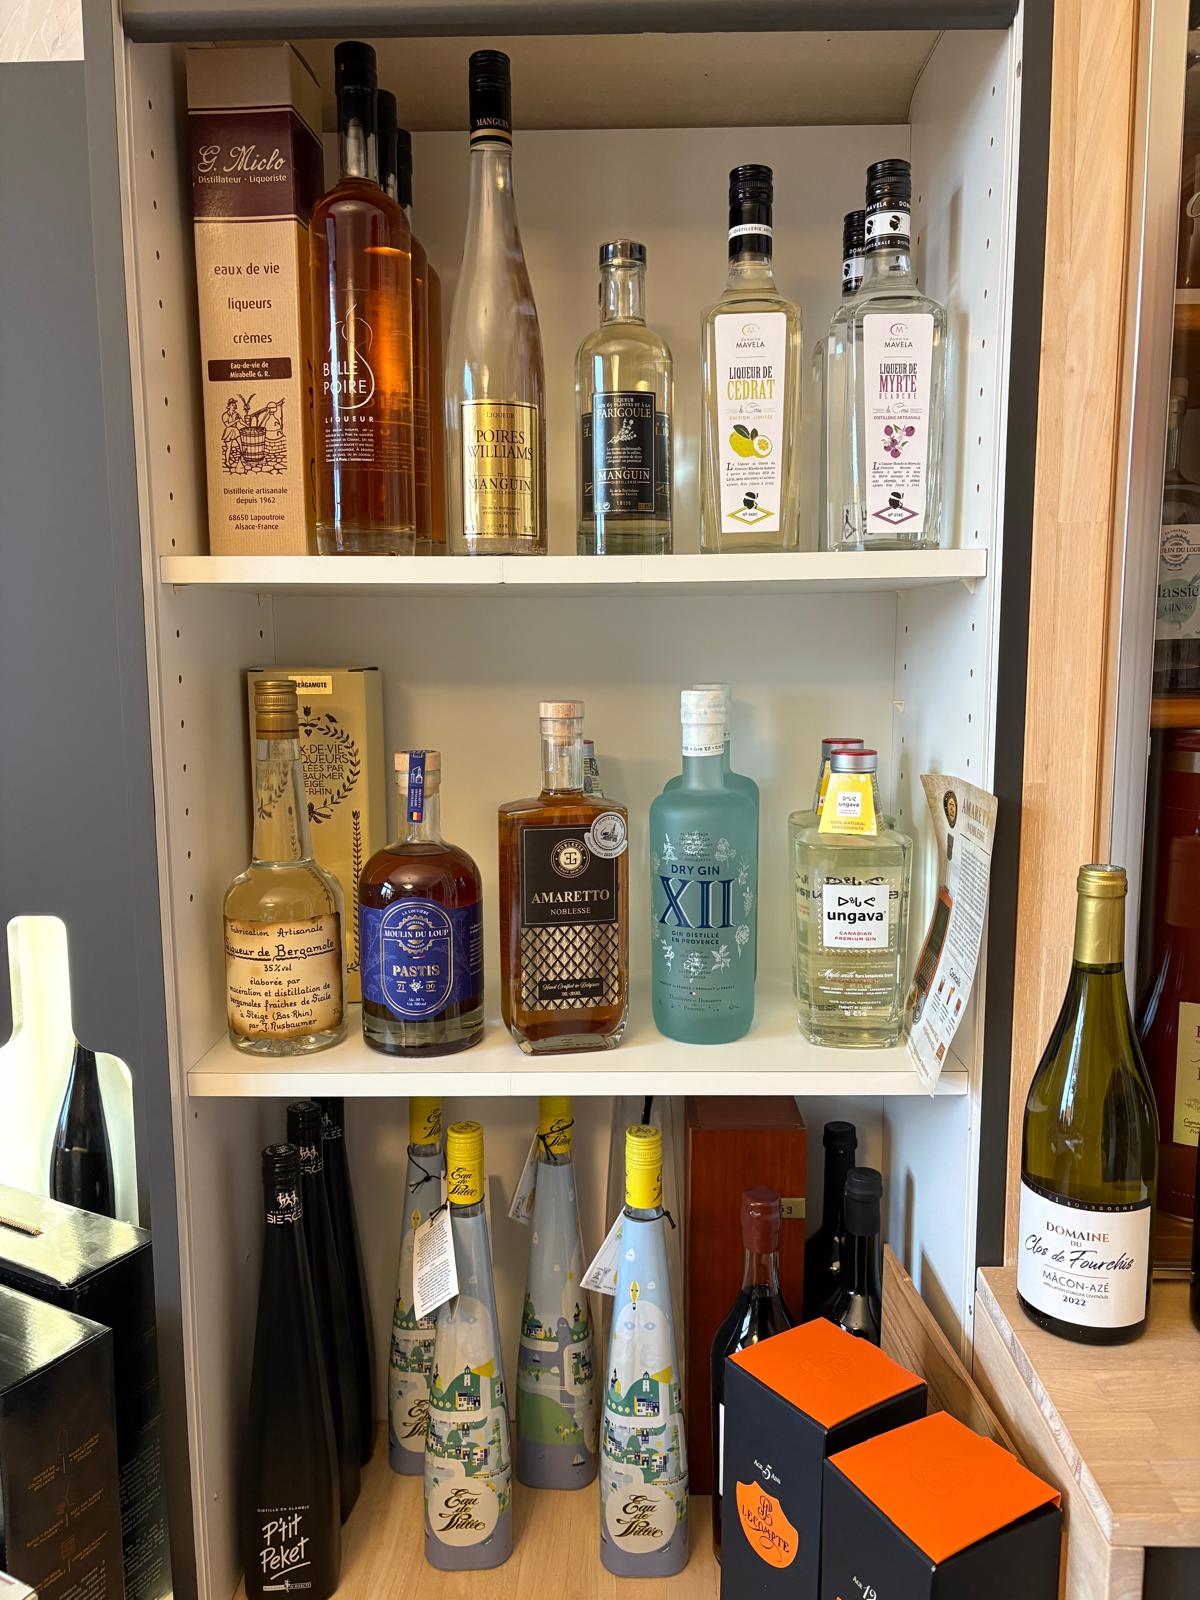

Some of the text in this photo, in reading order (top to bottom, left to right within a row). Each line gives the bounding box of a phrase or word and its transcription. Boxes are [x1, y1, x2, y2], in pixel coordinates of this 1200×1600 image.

[198, 145, 286, 172] G. Miclo
[198, 175, 242, 184] Distillateur
[249, 173, 288, 184] Liquoriste
[214, 261, 281, 275] eaux de vie
[227, 297, 273, 311] liqueurs
[233, 332, 273, 344] crèmes
[735, 341, 766, 349] MAVELA
[230, 360, 269, 370] Eau-de-vie de
[879, 363, 918, 375] LIQUEUR DE
[229, 370, 256, 379] Mirabelle
[264, 369, 271, 377] R.
[729, 365, 773, 380] LIQUEUR DE
[323, 379, 367, 395] POIRE
[727, 379, 776, 400] CEDRAT
[879, 374, 918, 393] MYRTE
[325, 415, 374, 424] LIQUEUR
[476, 429, 525, 445] POIRES
[468, 445, 533, 461] WILLIAMS
[599, 470, 650, 481] MANGUIN
[223, 486, 288, 495] Distillerie artisanale
[468, 477, 532, 492] MANGUIN
[236, 496, 276, 505] depuis 1962
[250, 513, 285, 522] Lapoutroie
[327, 765, 345, 773] PAR
[671, 864, 720, 876] DRY GIN
[531, 888, 610, 904] AMARETTO
[659, 874, 737, 929] XII
[550, 907, 591, 916] NOBLESSE
[827, 911, 884, 925] ungava
[384, 928, 449, 938] MOULIN DU LOUP
[257, 938, 335, 961] de Bergamote
[391, 964, 441, 978] PASTIS
[250, 976, 301, 987] élaborée par
[264, 988, 272, 997] et
[274, 984, 321, 997] distillation
[322, 982, 331, 990] de
[300, 996, 310, 1006] de
[246, 1009, 269, 1023] Steige
[450, 1167, 474, 1179] Eau
[1046, 1221, 1110, 1243] DOMAINE
[1070, 1240, 1083, 1248] DU
[1024, 1234, 1135, 1271] Clos de Fourchis
[1042, 1269, 1110, 1293] MÂCON-AZÉ
[1062, 1295, 1087, 1307] 2022
[762, 1464, 773, 1480] 5
[444, 1488, 482, 1507] Eau
[622, 1494, 660, 1515] Eau
[453, 1505, 473, 1514] de
[633, 1512, 649, 1520] de
[259, 1536, 310, 1574] Peket
